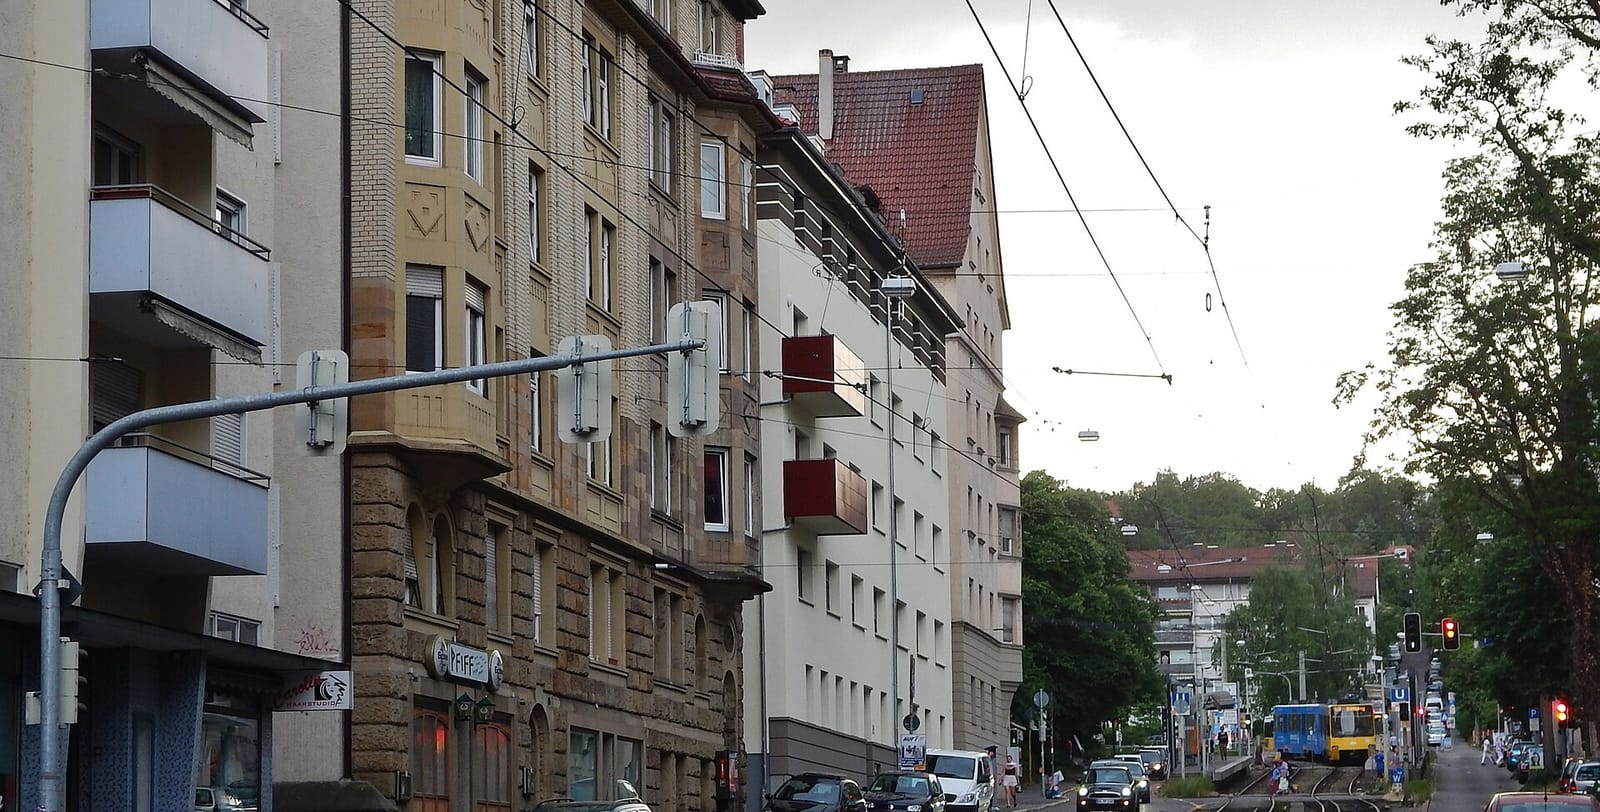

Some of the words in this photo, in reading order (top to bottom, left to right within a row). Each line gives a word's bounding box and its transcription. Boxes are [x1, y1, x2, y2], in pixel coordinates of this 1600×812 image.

[450, 647, 474, 676] PFIFF
[1395, 688, 1405, 699] U
[1530, 708, 1536, 718] P
